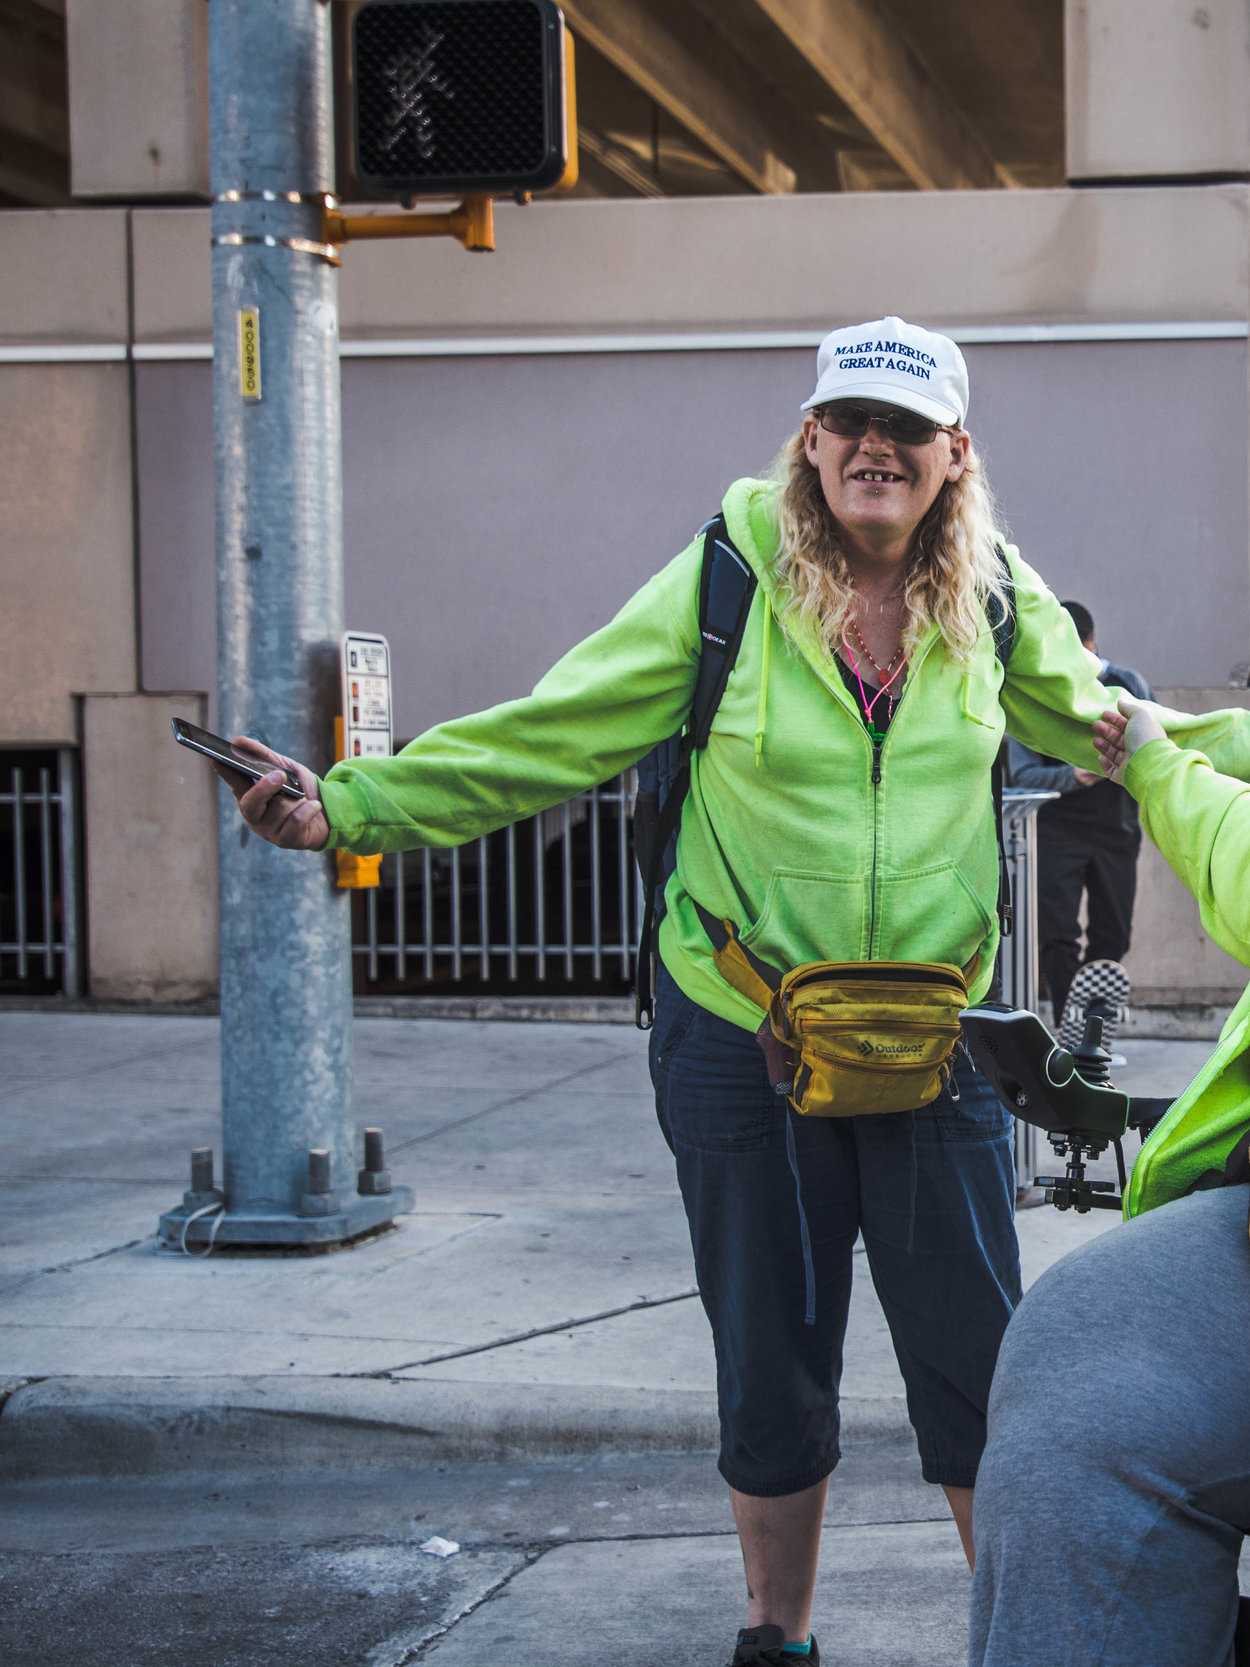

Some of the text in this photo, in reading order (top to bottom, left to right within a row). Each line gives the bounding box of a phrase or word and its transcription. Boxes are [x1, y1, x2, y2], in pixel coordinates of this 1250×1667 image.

[834, 340, 938, 368] MAKE AMERICA
[839, 356, 931, 381] GREAT AGAIN
[875, 1042, 925, 1053] Outdoor
